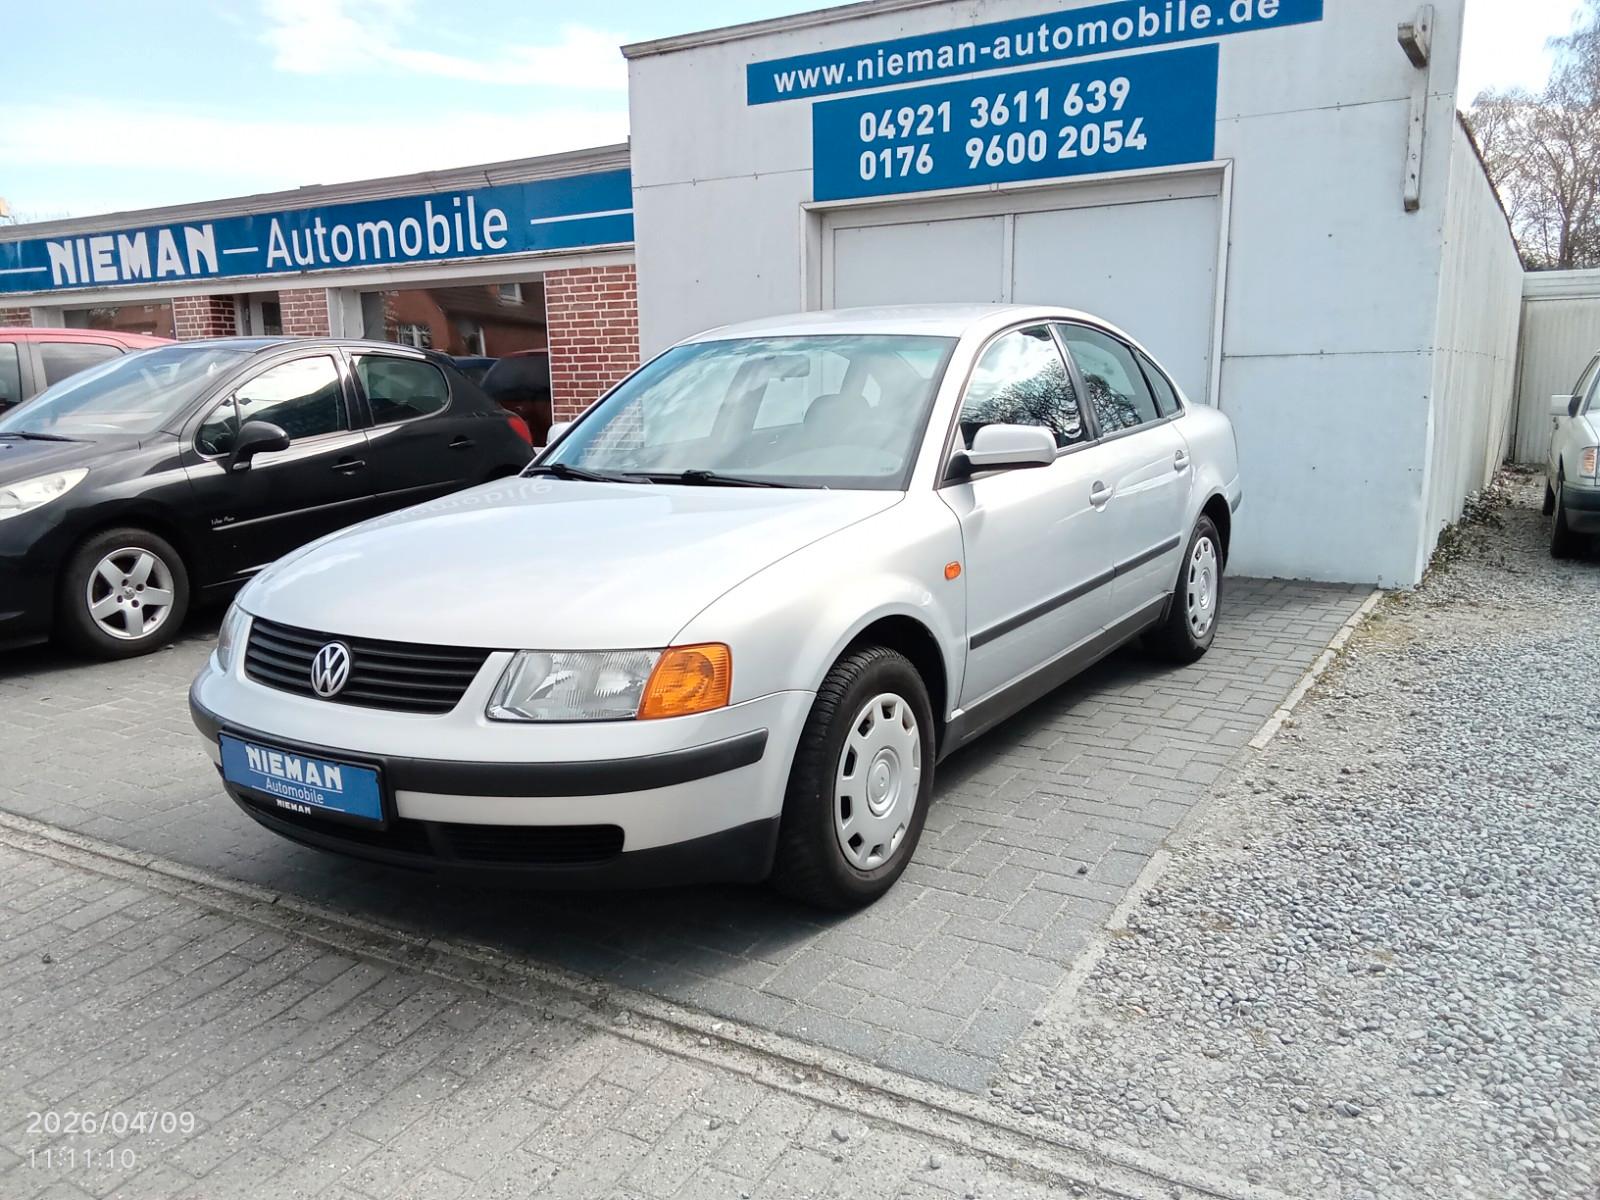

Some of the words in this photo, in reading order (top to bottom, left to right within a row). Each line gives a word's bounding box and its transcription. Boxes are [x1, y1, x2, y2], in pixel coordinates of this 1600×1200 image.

[774, 0, 1280, 93] www.nieman-automobile.de
[859, 102, 951, 143] 04921
[970, 88, 1050, 129] 3611
[1064, 77, 1131, 117] 639
[859, 143, 934, 181] 0176
[966, 130, 1048, 170] 9600
[1058, 117, 1147, 159] 2054
[46, 225, 219, 285] NIEMAN
[266, 196, 507, 268] Automobile
[246, 746, 342, 790] NIEMAN
[266, 777, 323, 804] Automobile
[276, 798, 311, 815] NIEMAN
